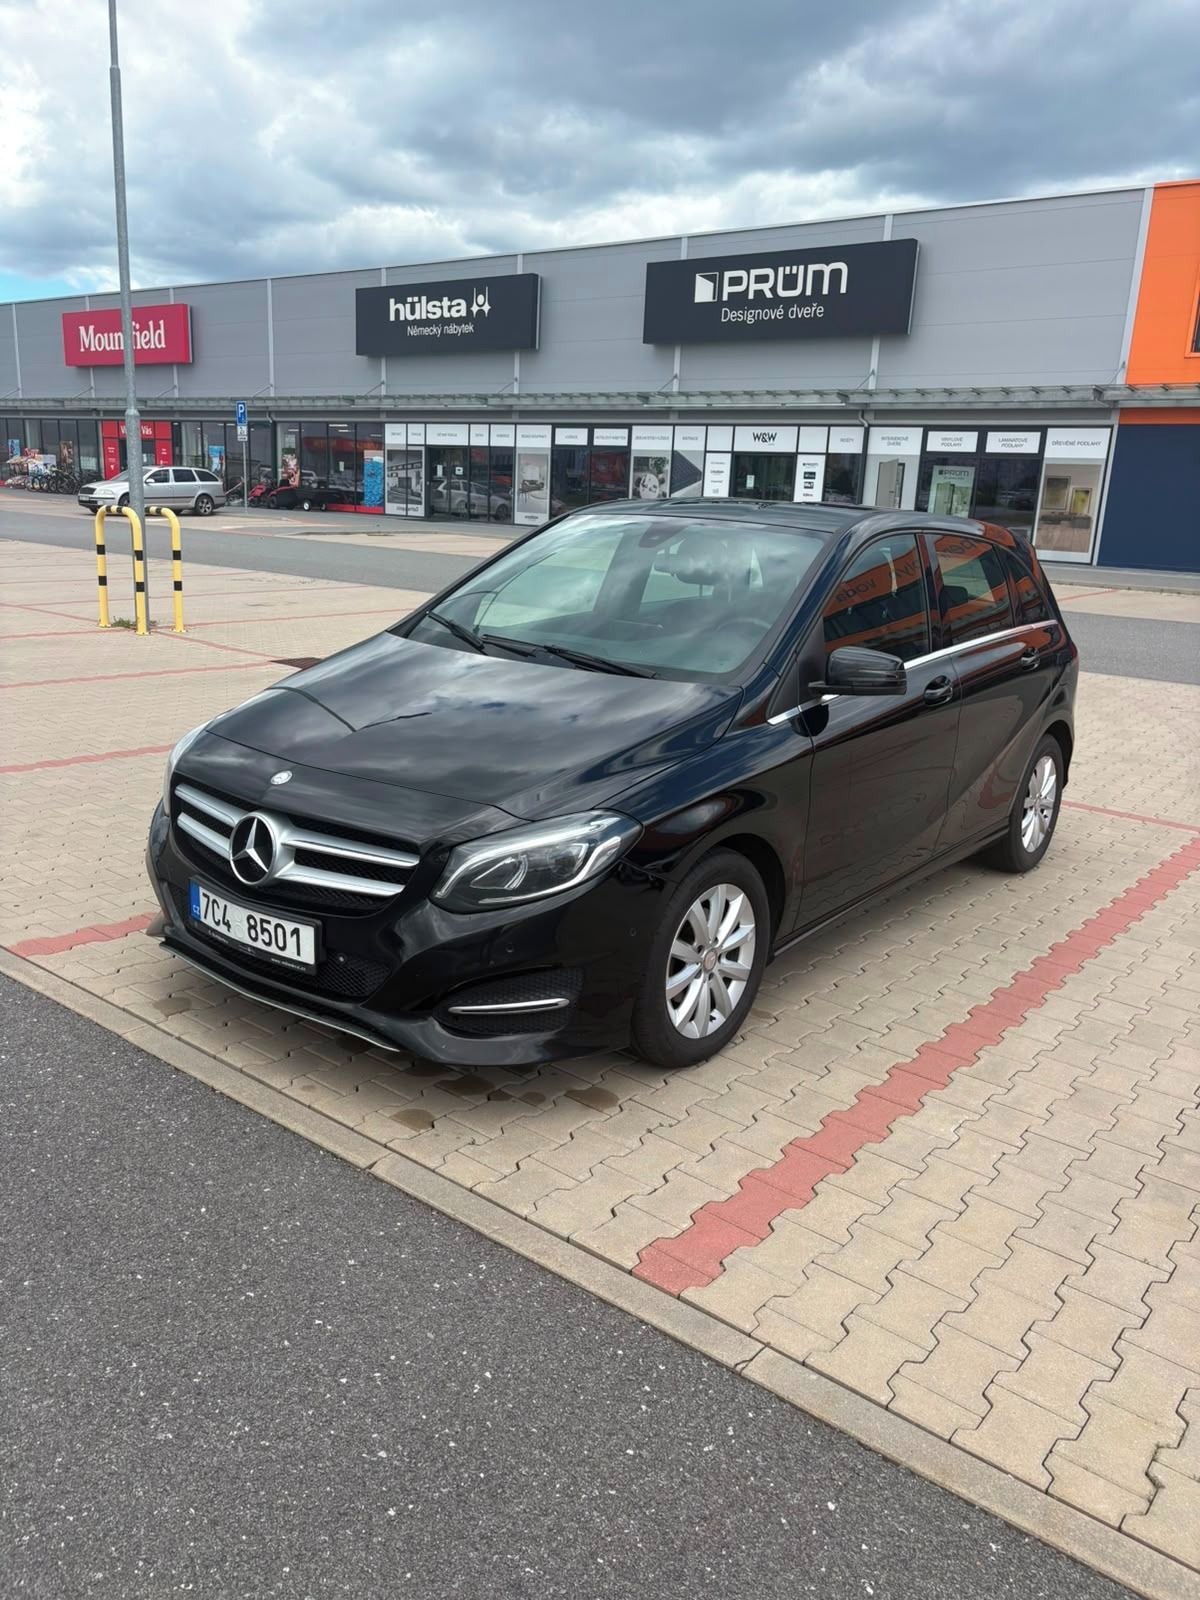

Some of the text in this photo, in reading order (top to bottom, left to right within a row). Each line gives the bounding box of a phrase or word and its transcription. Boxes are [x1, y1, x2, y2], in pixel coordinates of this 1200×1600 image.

[722, 261, 849, 302] PRÜM
[389, 295, 467, 322] hülsta
[721, 302, 824, 324] Designové dveře
[407, 321, 475, 337] Německý nábytek
[238, 404, 245, 418] P
[752, 431, 777, 443] W&W
[202, 893, 301, 957] 7C4 8501
